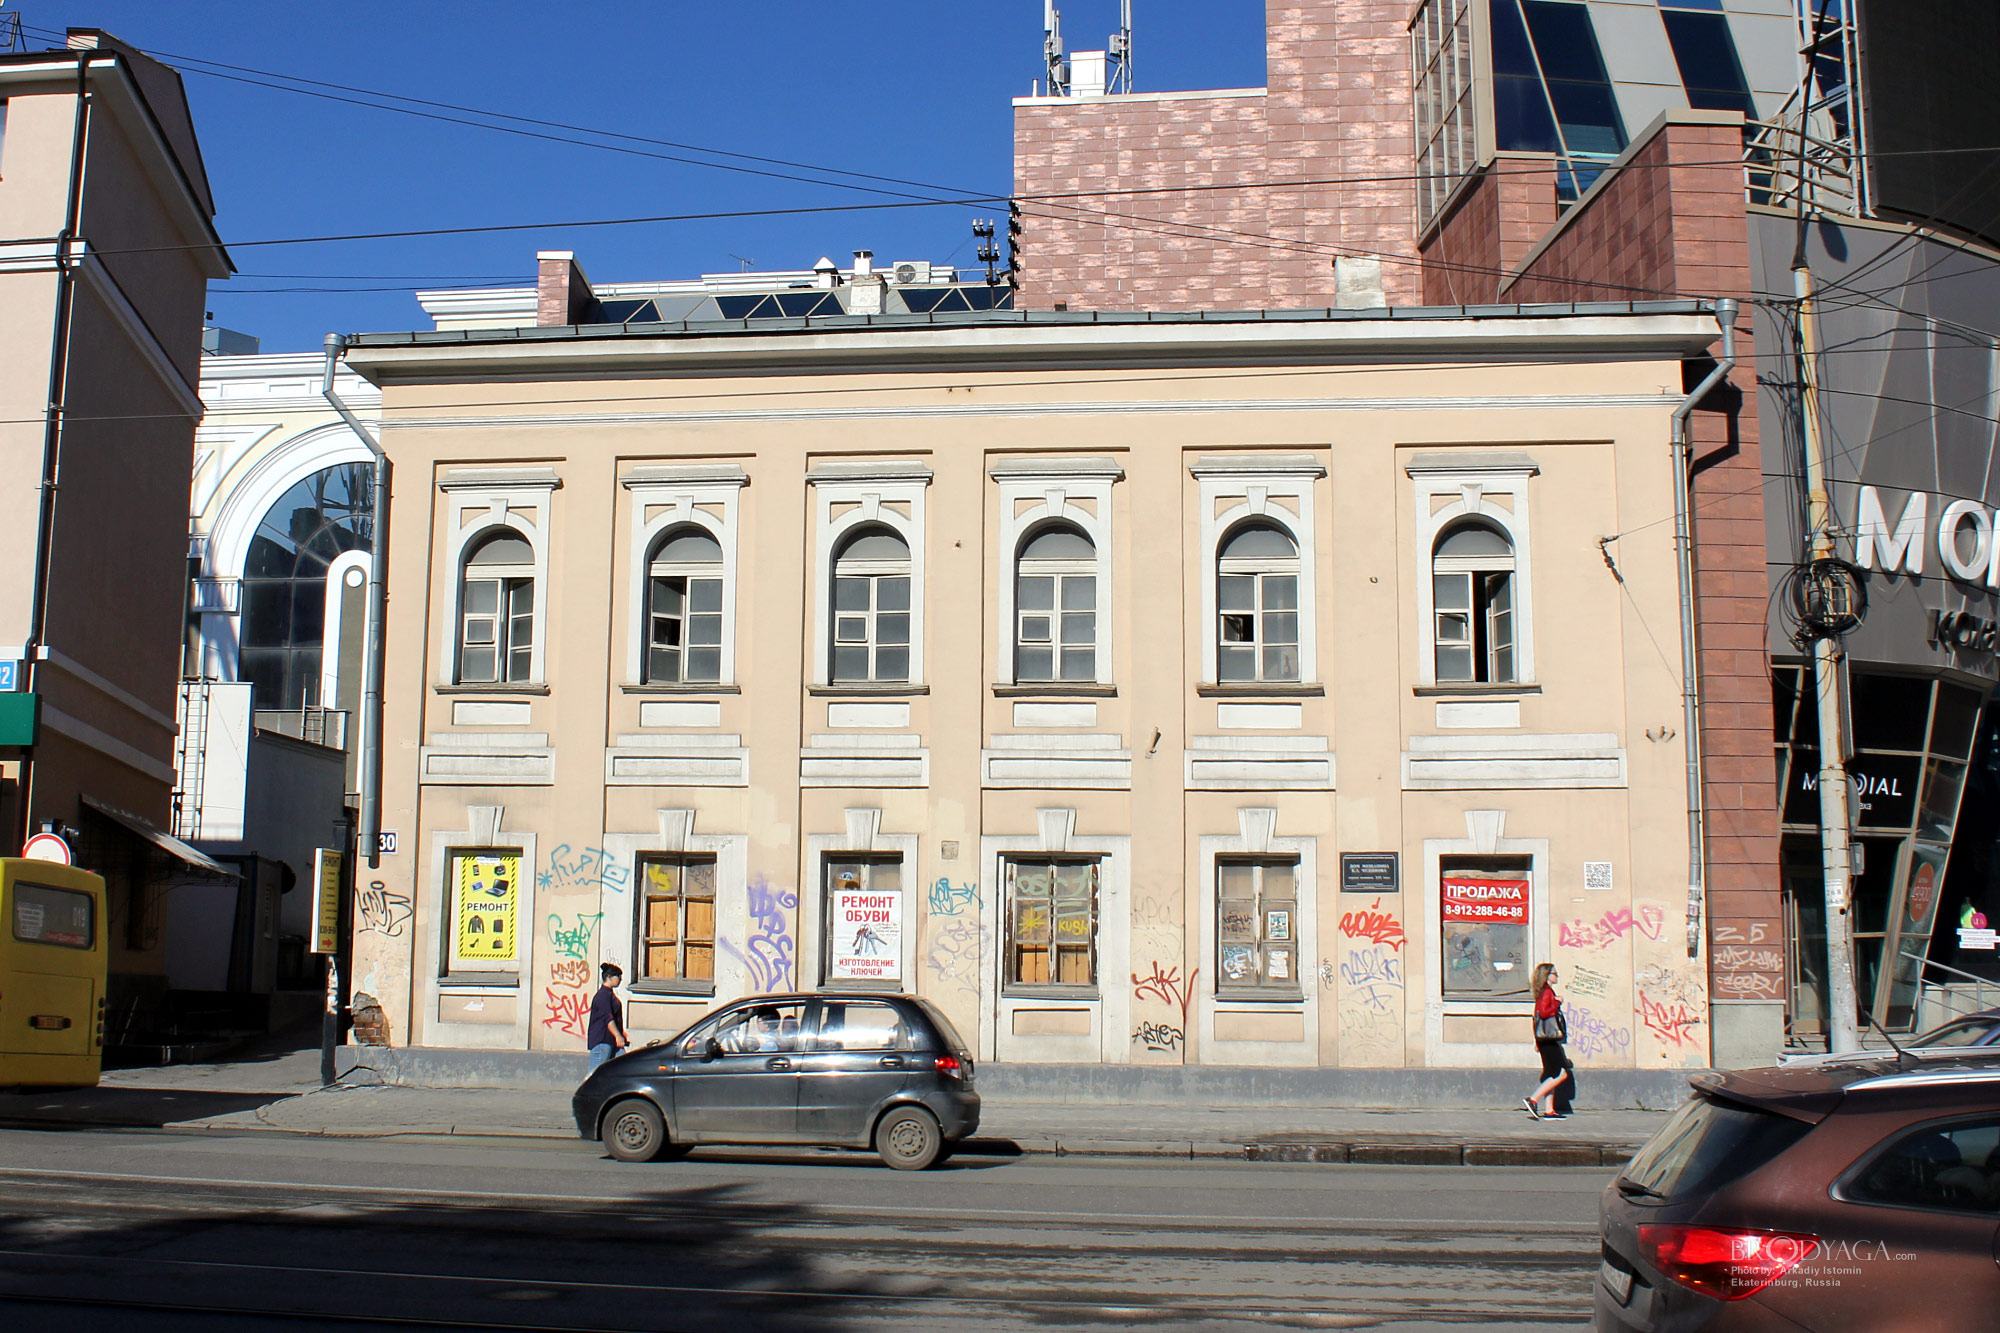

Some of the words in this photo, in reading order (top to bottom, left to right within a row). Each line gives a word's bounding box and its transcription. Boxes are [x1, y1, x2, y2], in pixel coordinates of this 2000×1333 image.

[0, 666, 11, 685] 2
[378, 833, 396, 851] 30
[1446, 885, 1522, 900] ПРОДАЖА
[466, 902, 509, 912] РЕМОНТ
[841, 896, 895, 908] РЕМОНТ
[845, 910, 890, 923] ОБУВИ
[1445, 904, 1523, 917] 8-912-288-46-88
[839, 958, 895, 967] ИЗГОТОВЛЕНИЕ
[850, 967, 882, 976] КЛЮЧЕЙ
